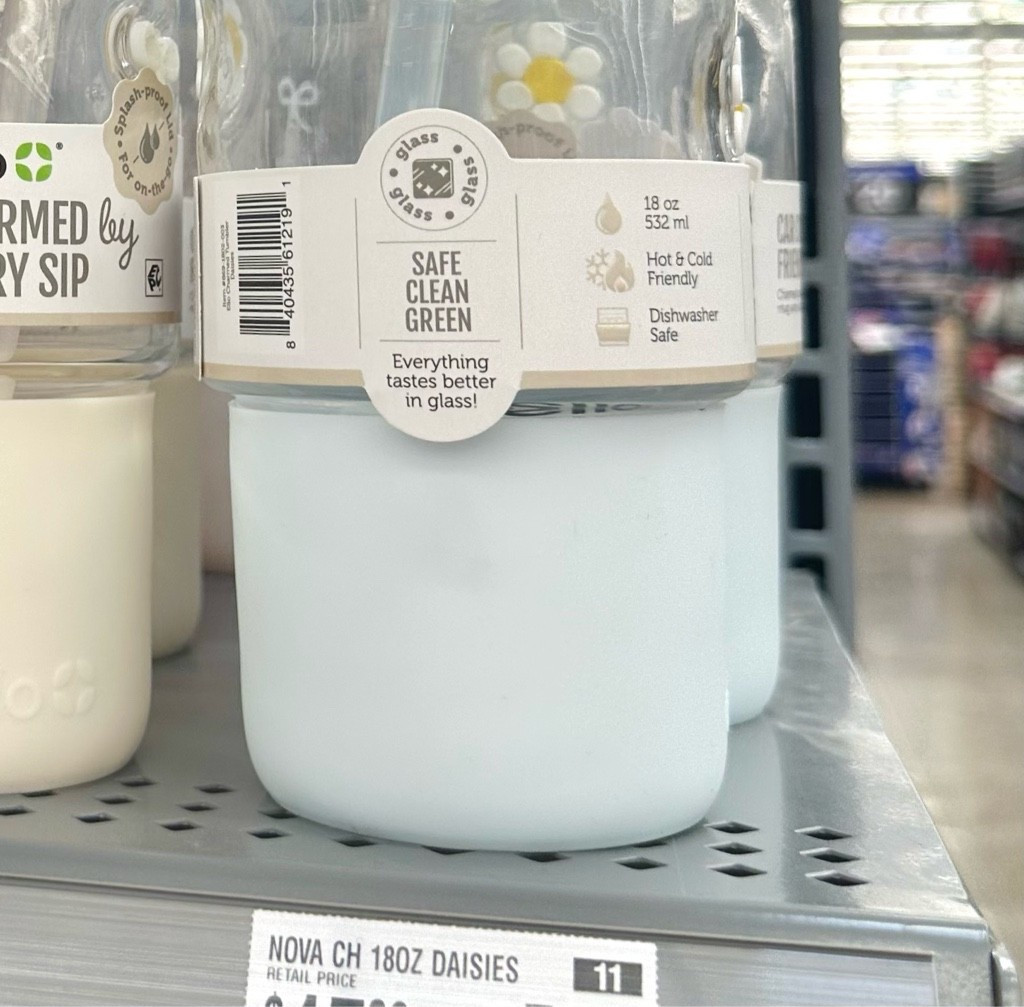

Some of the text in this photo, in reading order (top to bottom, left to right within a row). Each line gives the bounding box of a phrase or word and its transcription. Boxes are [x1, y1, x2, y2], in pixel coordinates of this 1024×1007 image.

[114, 86, 168, 136] Splash-proof
[396, 133, 439, 161] glass
[118, 152, 172, 196] For on-the-go
[461, 156, 478, 207] glass
[389, 187, 433, 221] glass
[644, 195, 679, 211] 18 oz
[99, 196, 139, 270] by
[281, 208, 294, 260] 61219
[645, 214, 689, 230] 532 ml
[412, 251, 462, 276] SAFE
[647, 251, 713, 267] Hot & Cold
[39, 252, 89, 297] SIP
[648, 271, 698, 289] Friendly
[283, 266, 295, 318] 40435
[406, 279, 469, 304] CLEAN
[405, 307, 472, 332] GREEN
[650, 307, 719, 323] Dishwasher
[286, 340, 296, 349] 8
[650, 327, 679, 342] Safe
[392, 353, 489, 373] Everything
[387, 374, 496, 389] tastes better
[406, 393, 477, 412] in glass!
[268, 935, 323, 966] NOVA
[332, 941, 361, 969] CH
[432, 949, 519, 983] DAISIES
[266, 966, 357, 988] RETAIL PRICE
[593, 962, 623, 992] 11
